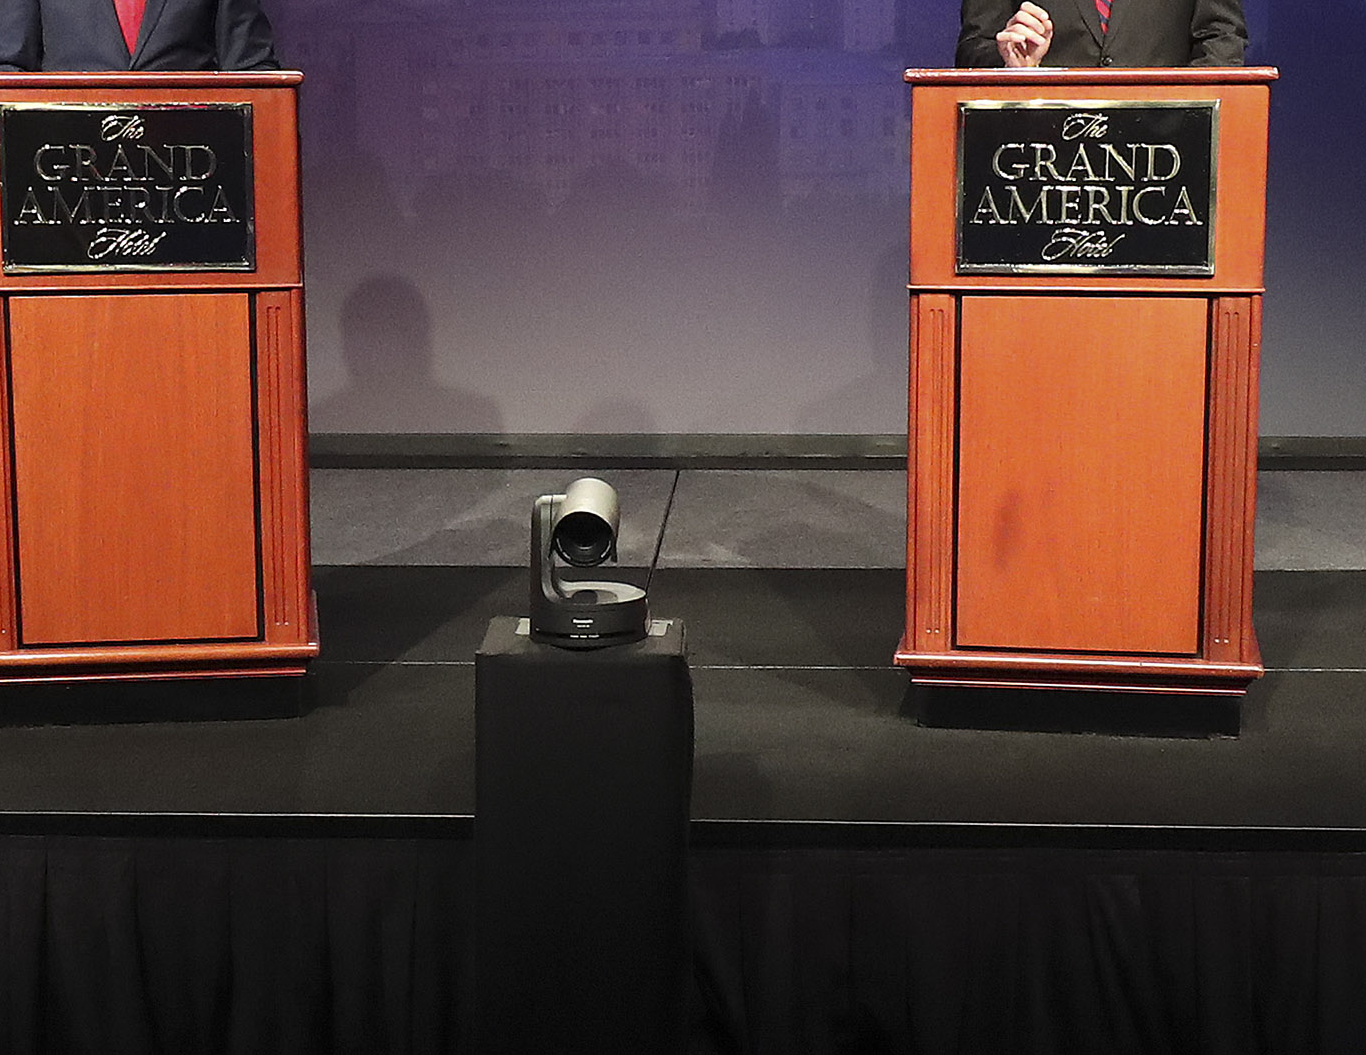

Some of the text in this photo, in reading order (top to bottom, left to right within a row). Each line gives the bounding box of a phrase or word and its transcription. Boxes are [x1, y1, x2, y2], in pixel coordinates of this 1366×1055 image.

[100, 114, 145, 141] The
[1061, 113, 1109, 141] The
[34, 144, 217, 181] GRAND
[991, 143, 1182, 181] GRAND
[13, 184, 241, 225] AMERICA
[969, 185, 1204, 226] AMERICA
[87, 227, 167, 260] Hotel
[1041, 227, 1126, 261] Hotel
